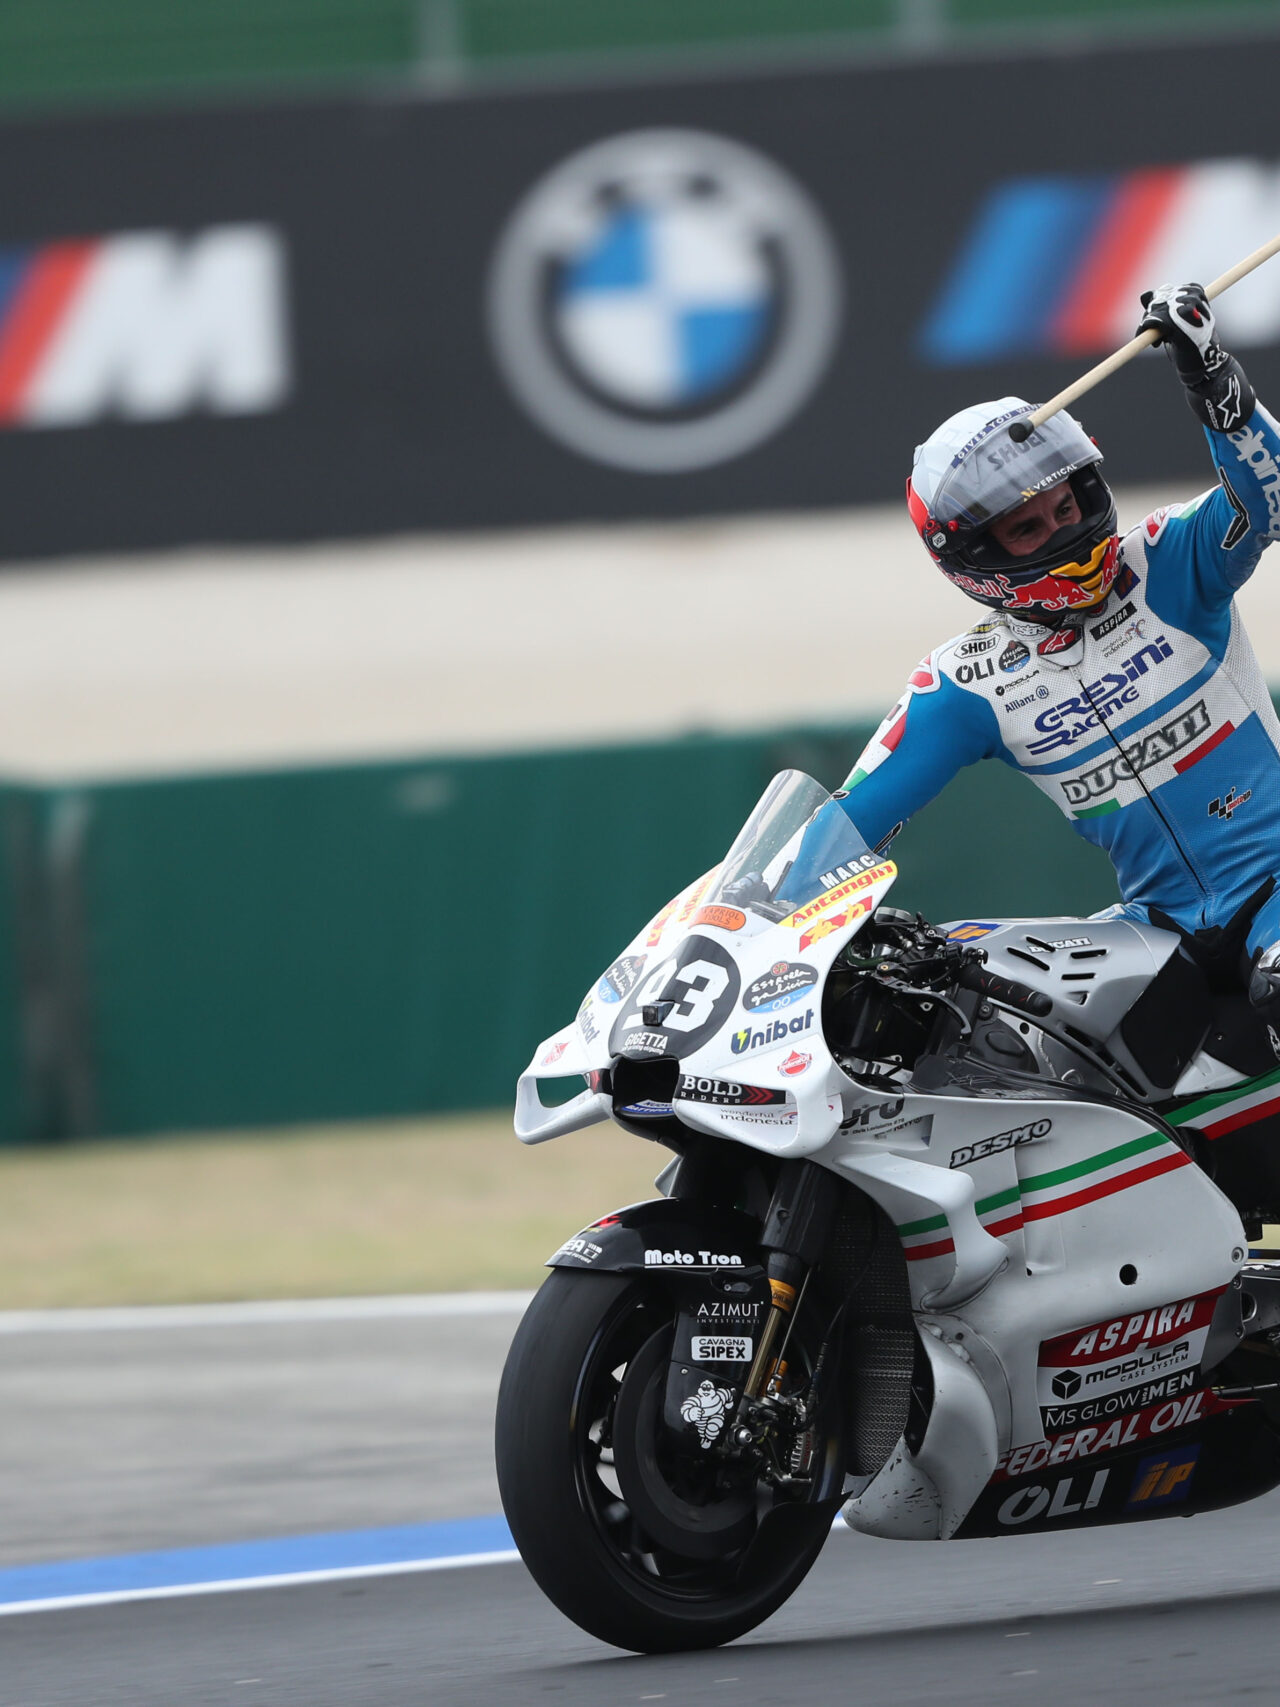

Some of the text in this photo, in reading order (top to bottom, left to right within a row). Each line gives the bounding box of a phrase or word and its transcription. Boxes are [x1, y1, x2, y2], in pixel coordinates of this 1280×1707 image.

[28, 224, 291, 427] M
[957, 431, 988, 460] GIVES
[989, 412, 1013, 429] YOU
[1033, 463, 1078, 490] VERTICAL
[1100, 608, 1128, 635] ASPIRA
[960, 635, 996, 656] SHOEI
[1004, 694, 1037, 714] Allianz
[1060, 699, 1213, 805] DUCATI
[819, 854, 876, 890] MARC
[792, 864, 894, 928] Antangin
[621, 958, 732, 1033] 93
[624, 1031, 669, 1051] GIGETTA
[730, 1007, 815, 1056] Unibat
[680, 1091, 741, 1104] RIDERS
[682, 1075, 742, 1096] BOLD
[720, 1107, 775, 1119] wonderful
[720, 1113, 794, 1126] indonesia
[950, 1119, 1052, 1169] DESMO
[644, 1249, 742, 1265] Moto Tron
[697, 1302, 760, 1317] AZIMUT
[699, 1338, 746, 1346] CAVAGNA
[1071, 1300, 1196, 1357] ASPIRA
[699, 1346, 746, 1359] SIPEX
[1120, 1353, 1189, 1383] CASE SYSTEM
[1045, 1406, 1077, 1429] MS
[1080, 1389, 1141, 1421] GLOW
[1148, 1371, 1195, 1399] MEN
[997, 1391, 1205, 1477] FEDERAL OIL
